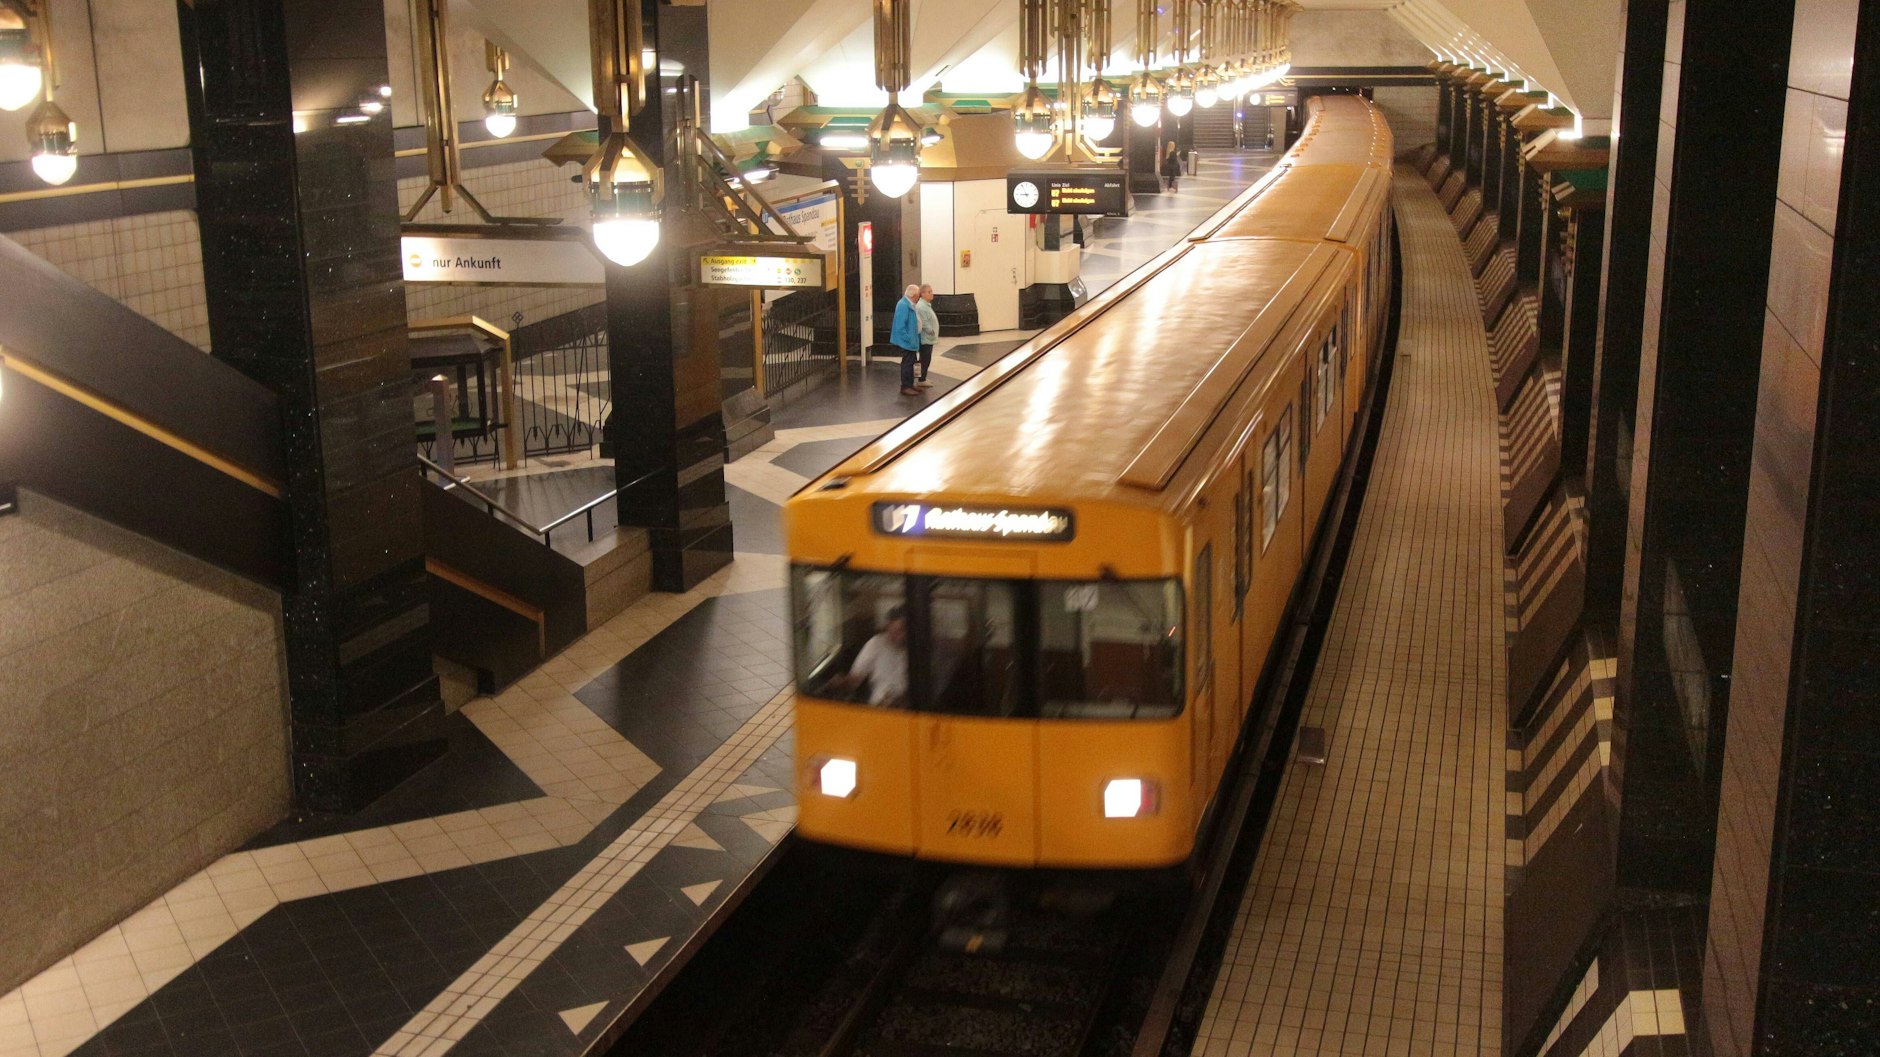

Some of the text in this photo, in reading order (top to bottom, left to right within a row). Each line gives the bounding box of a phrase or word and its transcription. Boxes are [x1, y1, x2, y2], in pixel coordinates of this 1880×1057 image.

[433, 257, 501, 269] nur Ankunft
[710, 258, 734, 266] Ausgang
